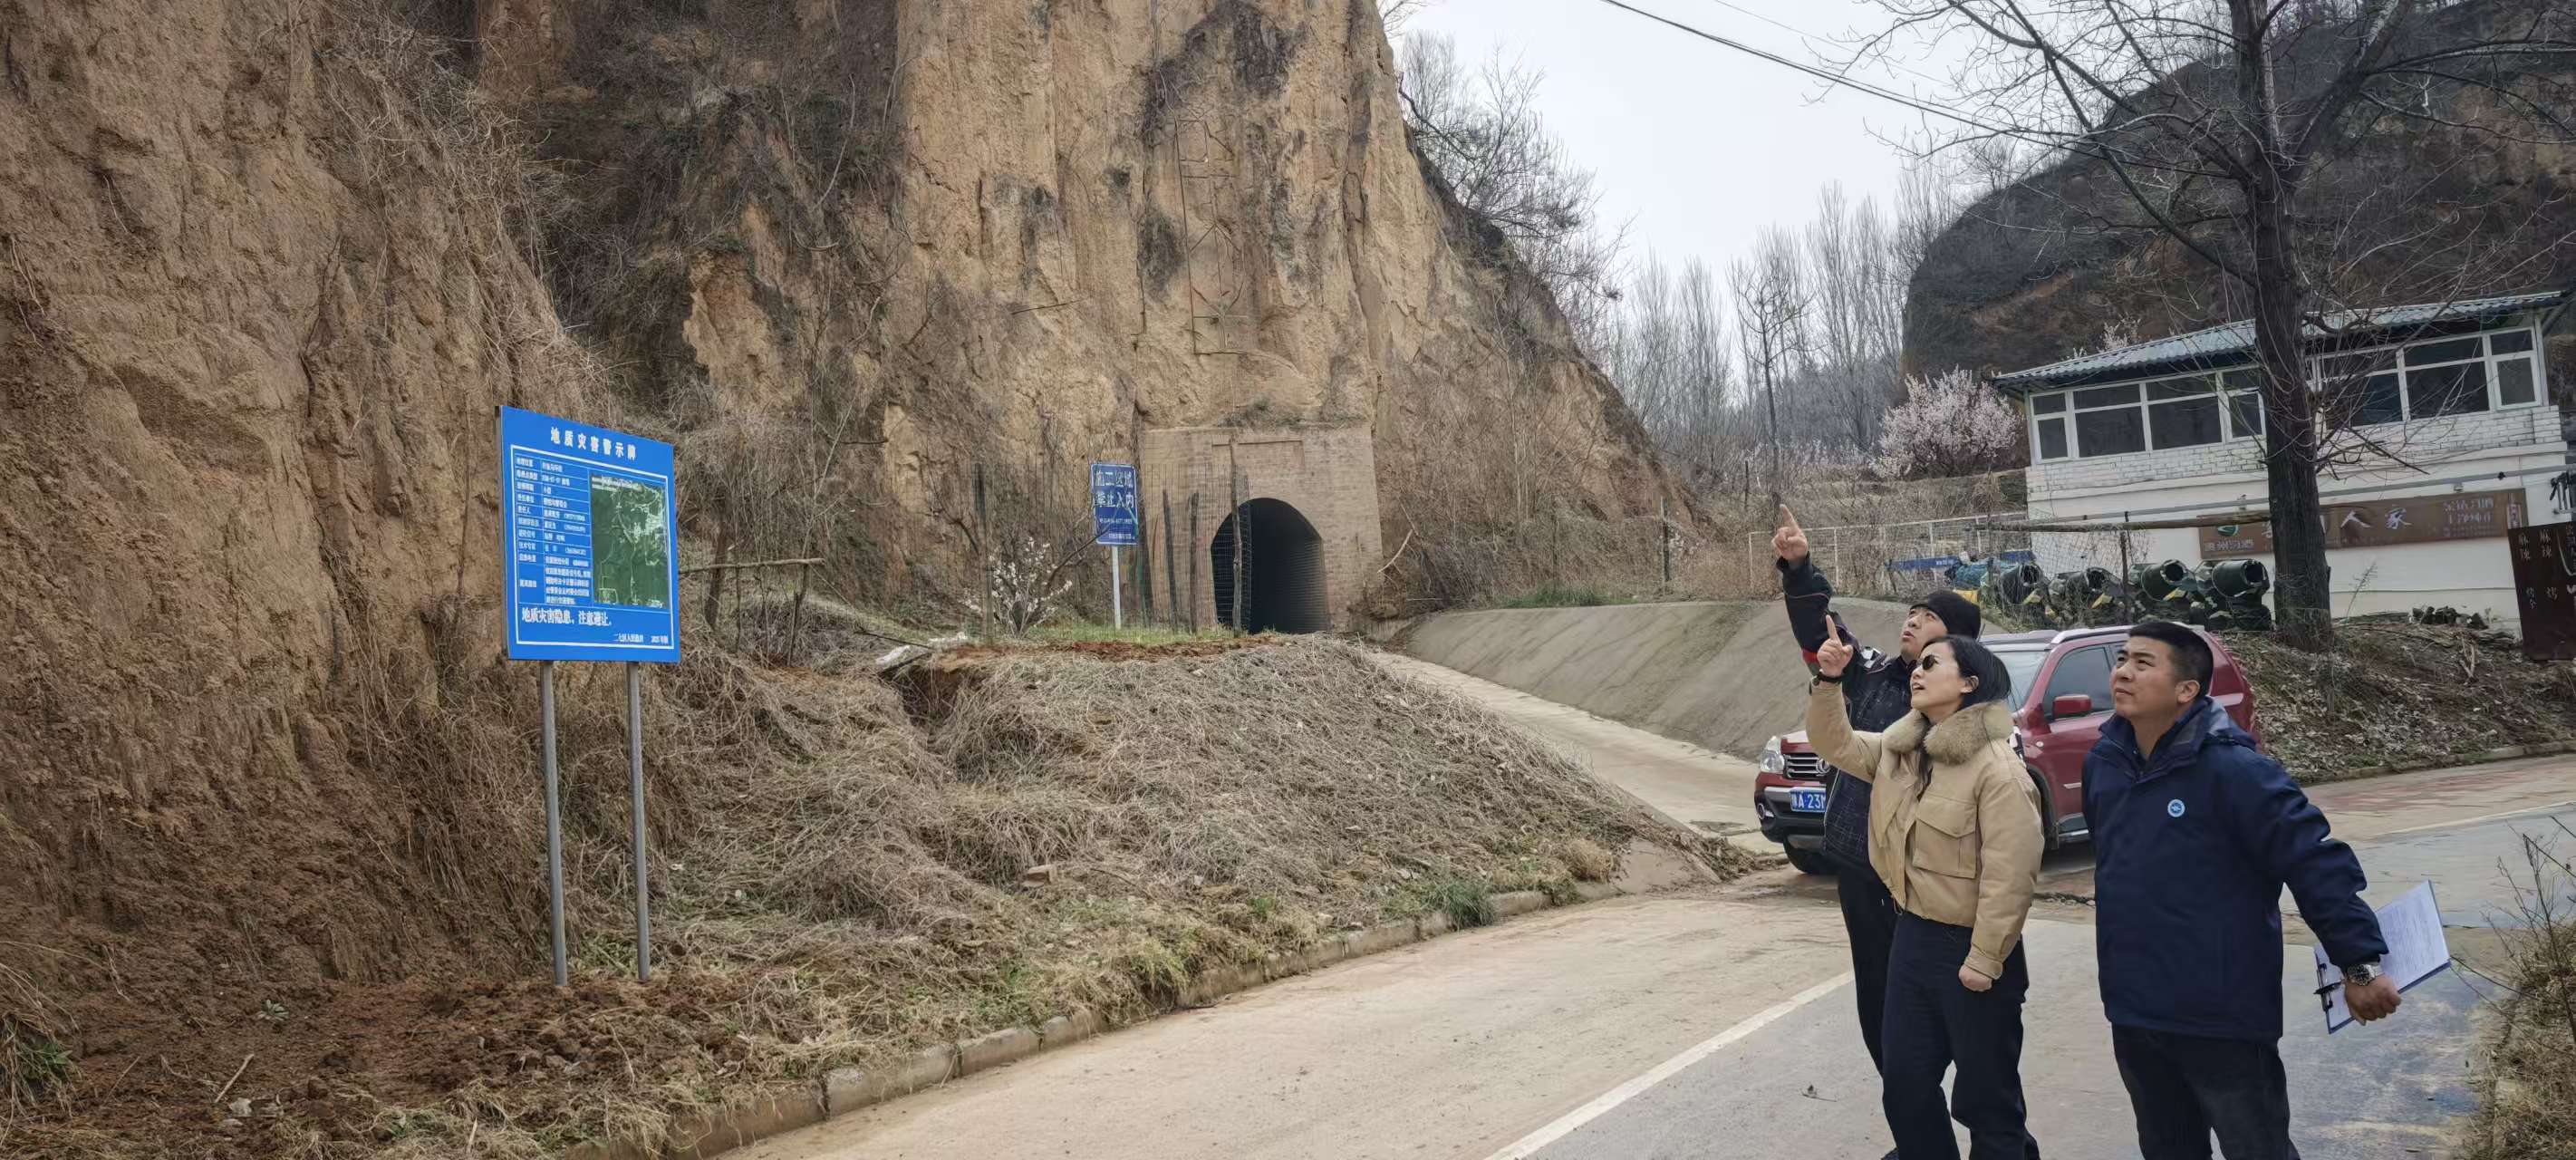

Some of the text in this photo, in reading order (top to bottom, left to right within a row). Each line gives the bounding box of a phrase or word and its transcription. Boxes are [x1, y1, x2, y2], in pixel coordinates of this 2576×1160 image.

[550, 427, 636, 460] 地质灾害警示牌
